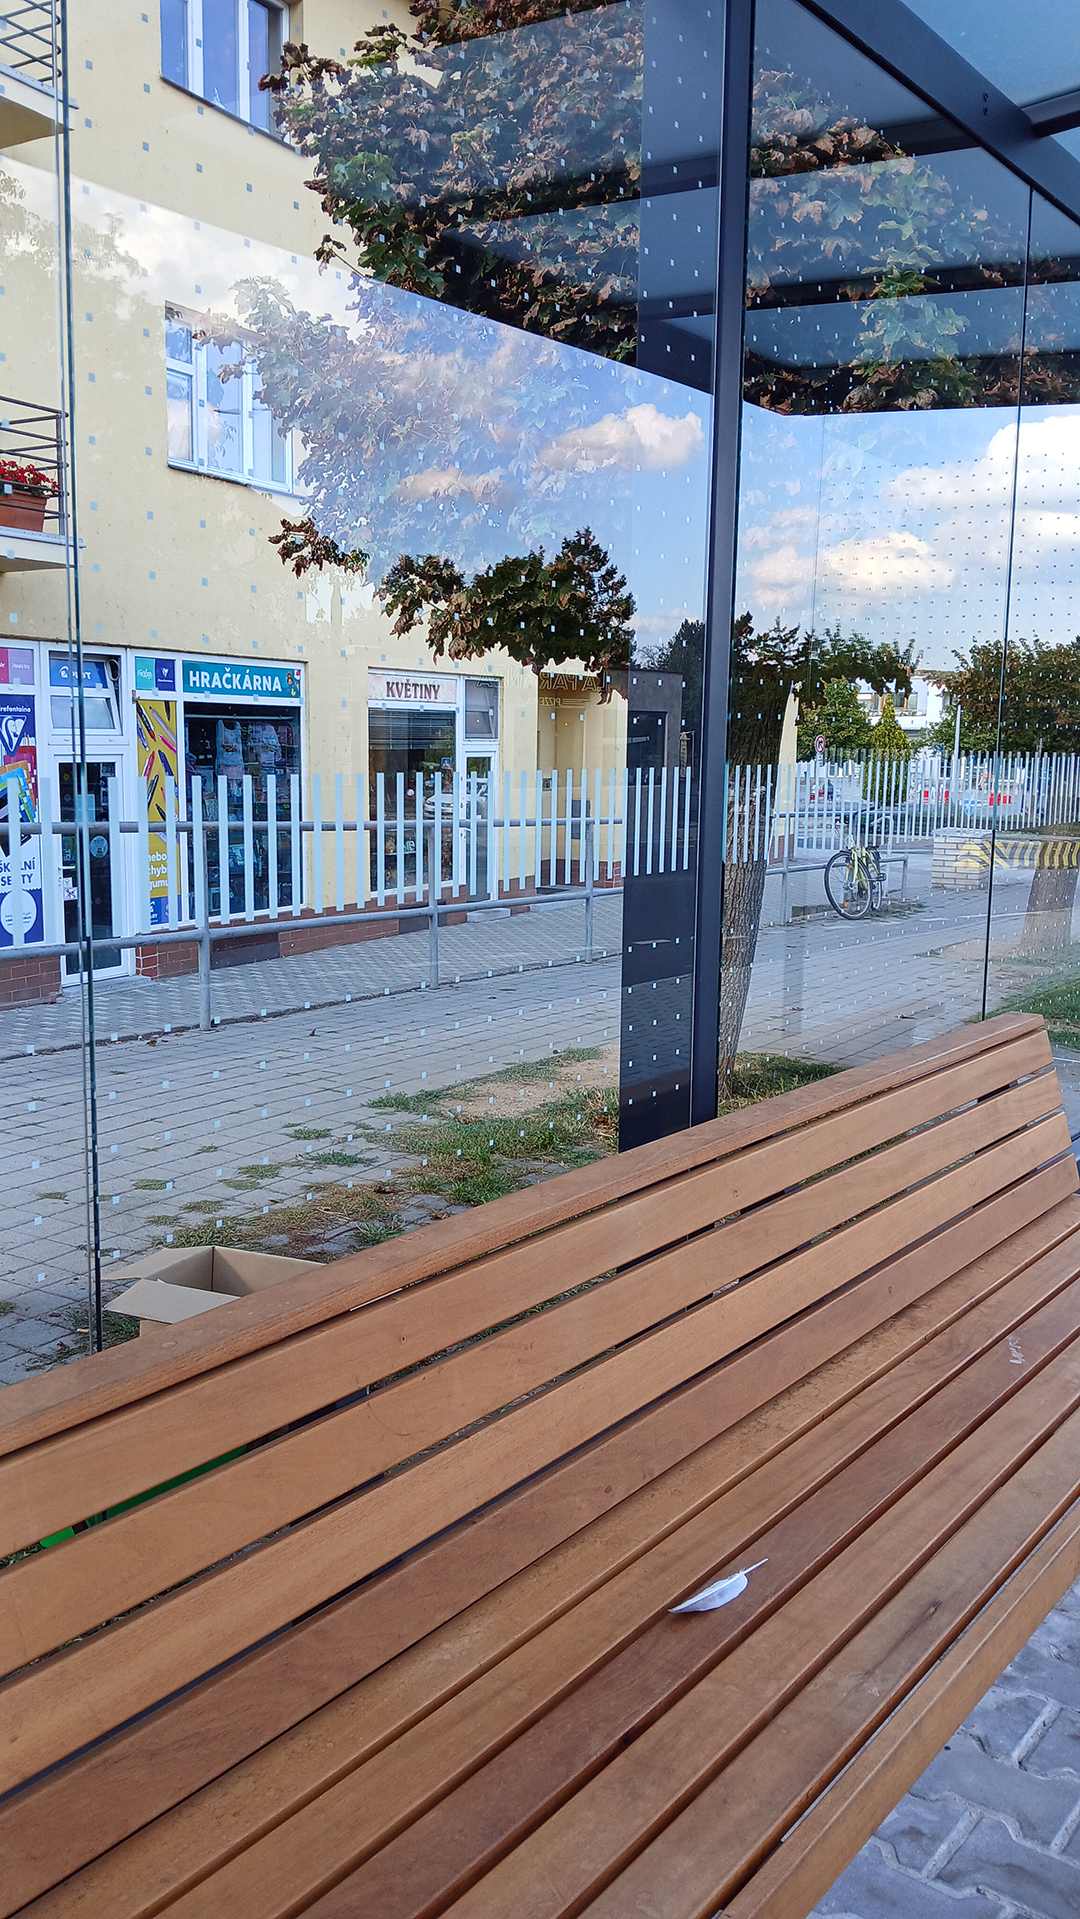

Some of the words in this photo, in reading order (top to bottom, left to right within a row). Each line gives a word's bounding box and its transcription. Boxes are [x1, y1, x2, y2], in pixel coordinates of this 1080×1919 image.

[71, 670, 91, 679] PIOT
[189, 667, 282, 692] HRAČKÁRNA
[386, 678, 440, 699] KVĚTINY
[0, 857, 35, 873] ŠKNÍ
[1, 873, 33, 886] SETY
